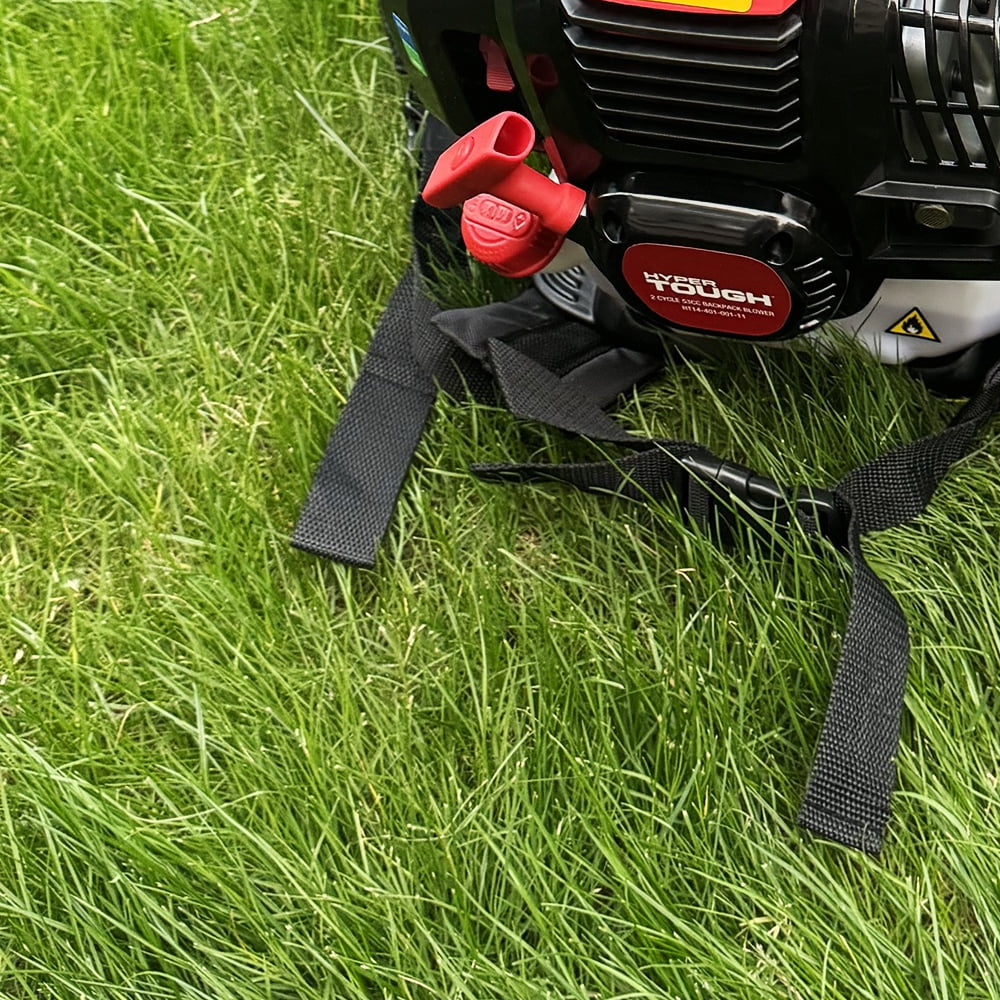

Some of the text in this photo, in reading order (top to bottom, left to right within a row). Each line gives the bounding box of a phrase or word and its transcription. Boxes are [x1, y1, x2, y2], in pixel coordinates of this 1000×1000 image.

[643, 271, 718, 288] HYPER
[645, 278, 773, 307] TOUGH
[656, 295, 680, 304] CYCLE
[681, 298, 701, 306] 53CC
[702, 301, 742, 312] BACKPACK
[742, 307, 775, 317] BLOWER
[681, 305, 746, 319] HT14-401-001-11
